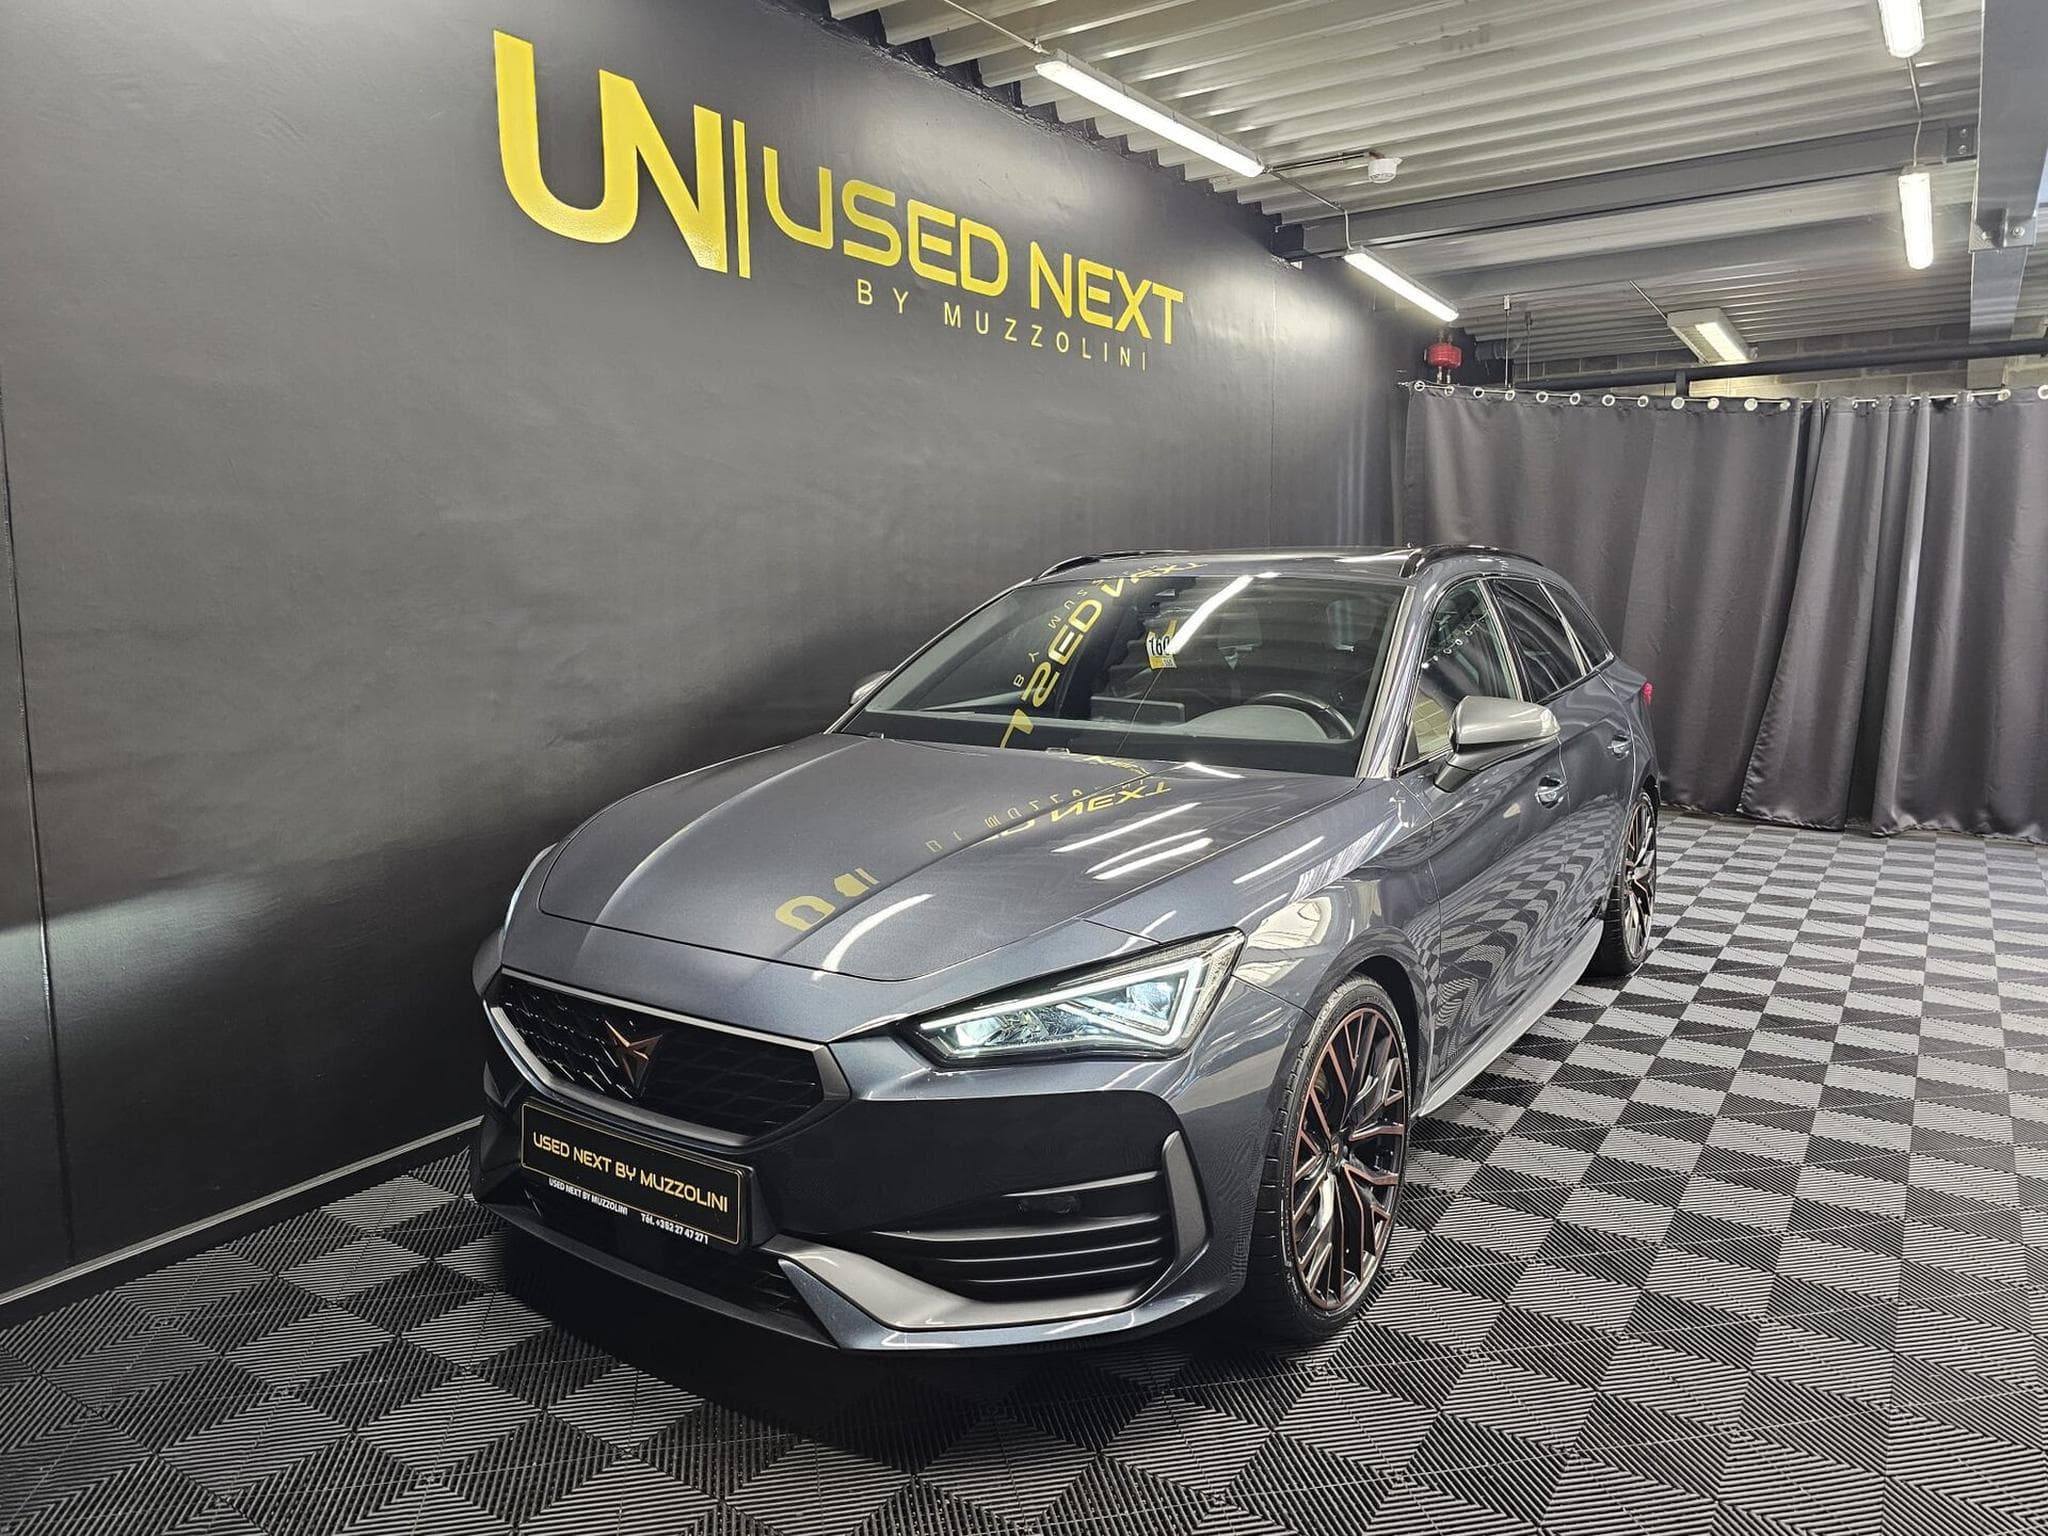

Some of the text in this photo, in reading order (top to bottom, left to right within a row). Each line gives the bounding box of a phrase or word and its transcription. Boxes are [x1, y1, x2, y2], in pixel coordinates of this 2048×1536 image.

[762, 145, 1186, 346] USED NEXT
[856, 278, 1146, 370] BY MUZZOLINI
[533, 1131, 728, 1213] USED NEXT BY MUZZOLINI
[548, 1177, 628, 1216] USED NEXT BY MUZZOLINI
[674, 1225, 684, 1236] 27
[684, 1228, 695, 1239] 47
